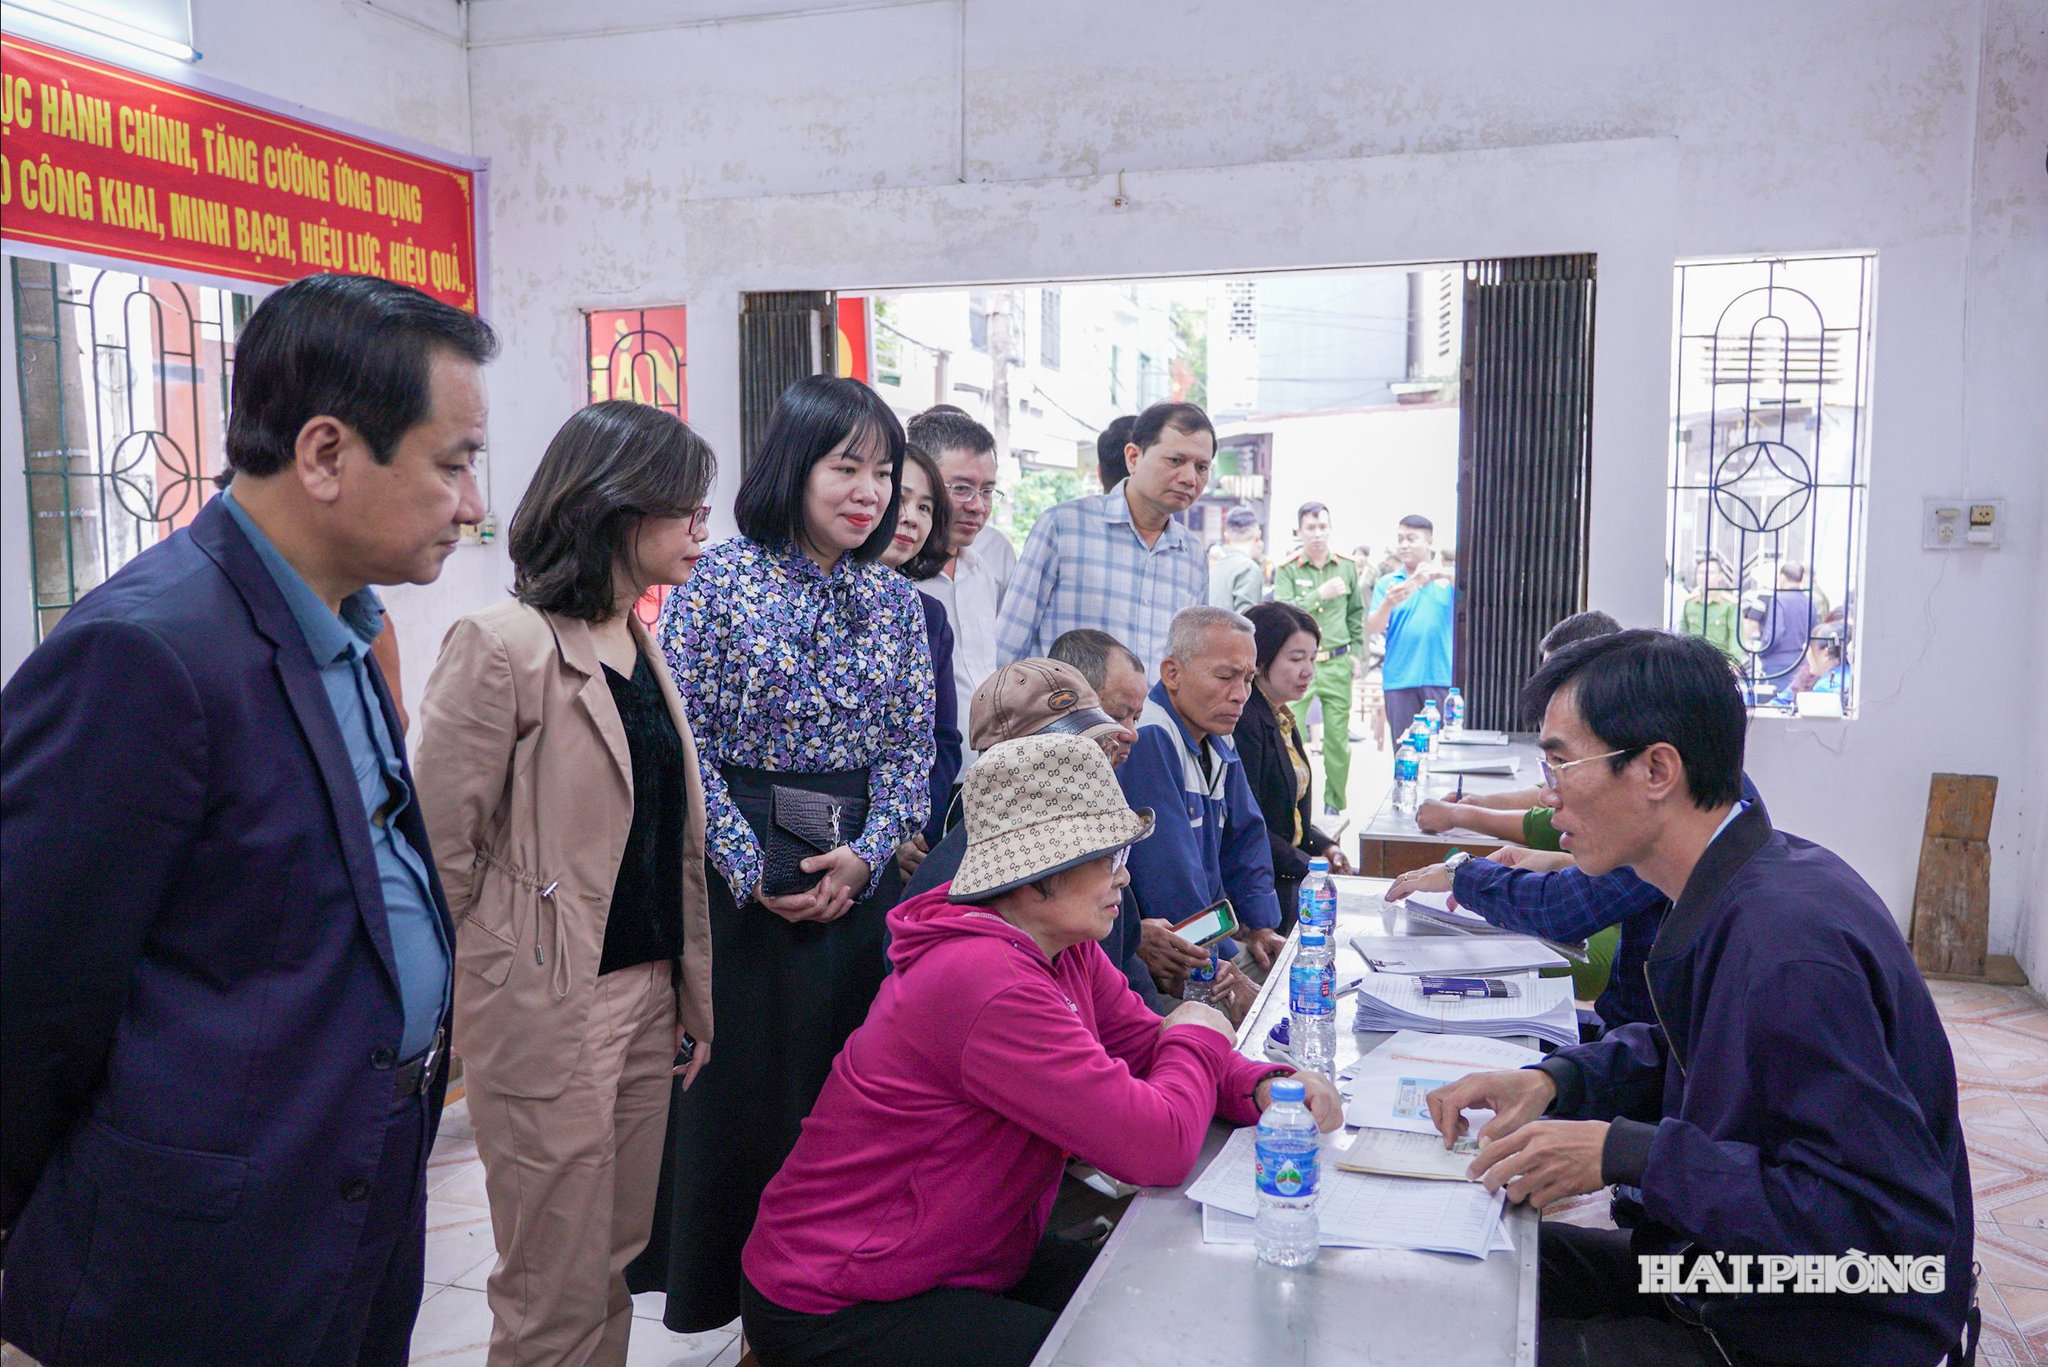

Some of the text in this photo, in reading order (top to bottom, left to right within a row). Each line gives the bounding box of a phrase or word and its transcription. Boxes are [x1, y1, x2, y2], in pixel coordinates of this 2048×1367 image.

[20, 153, 94, 221] CÔNG
[99, 176, 165, 241] KHAI,
[170, 193, 232, 248] MINH
[234, 207, 297, 265] BẠCH,
[300, 217, 344, 273] HIỆU
[430, 242, 466, 293] QUẢ.
[40, 78, 113, 149] HÀNH
[119, 104, 199, 176] CHÍNH,
[202, 122, 259, 185] TĂNG
[263, 142, 331, 202] CƯỜNG
[334, 156, 373, 213] ỨNG
[376, 175, 423, 227] DỤNG
